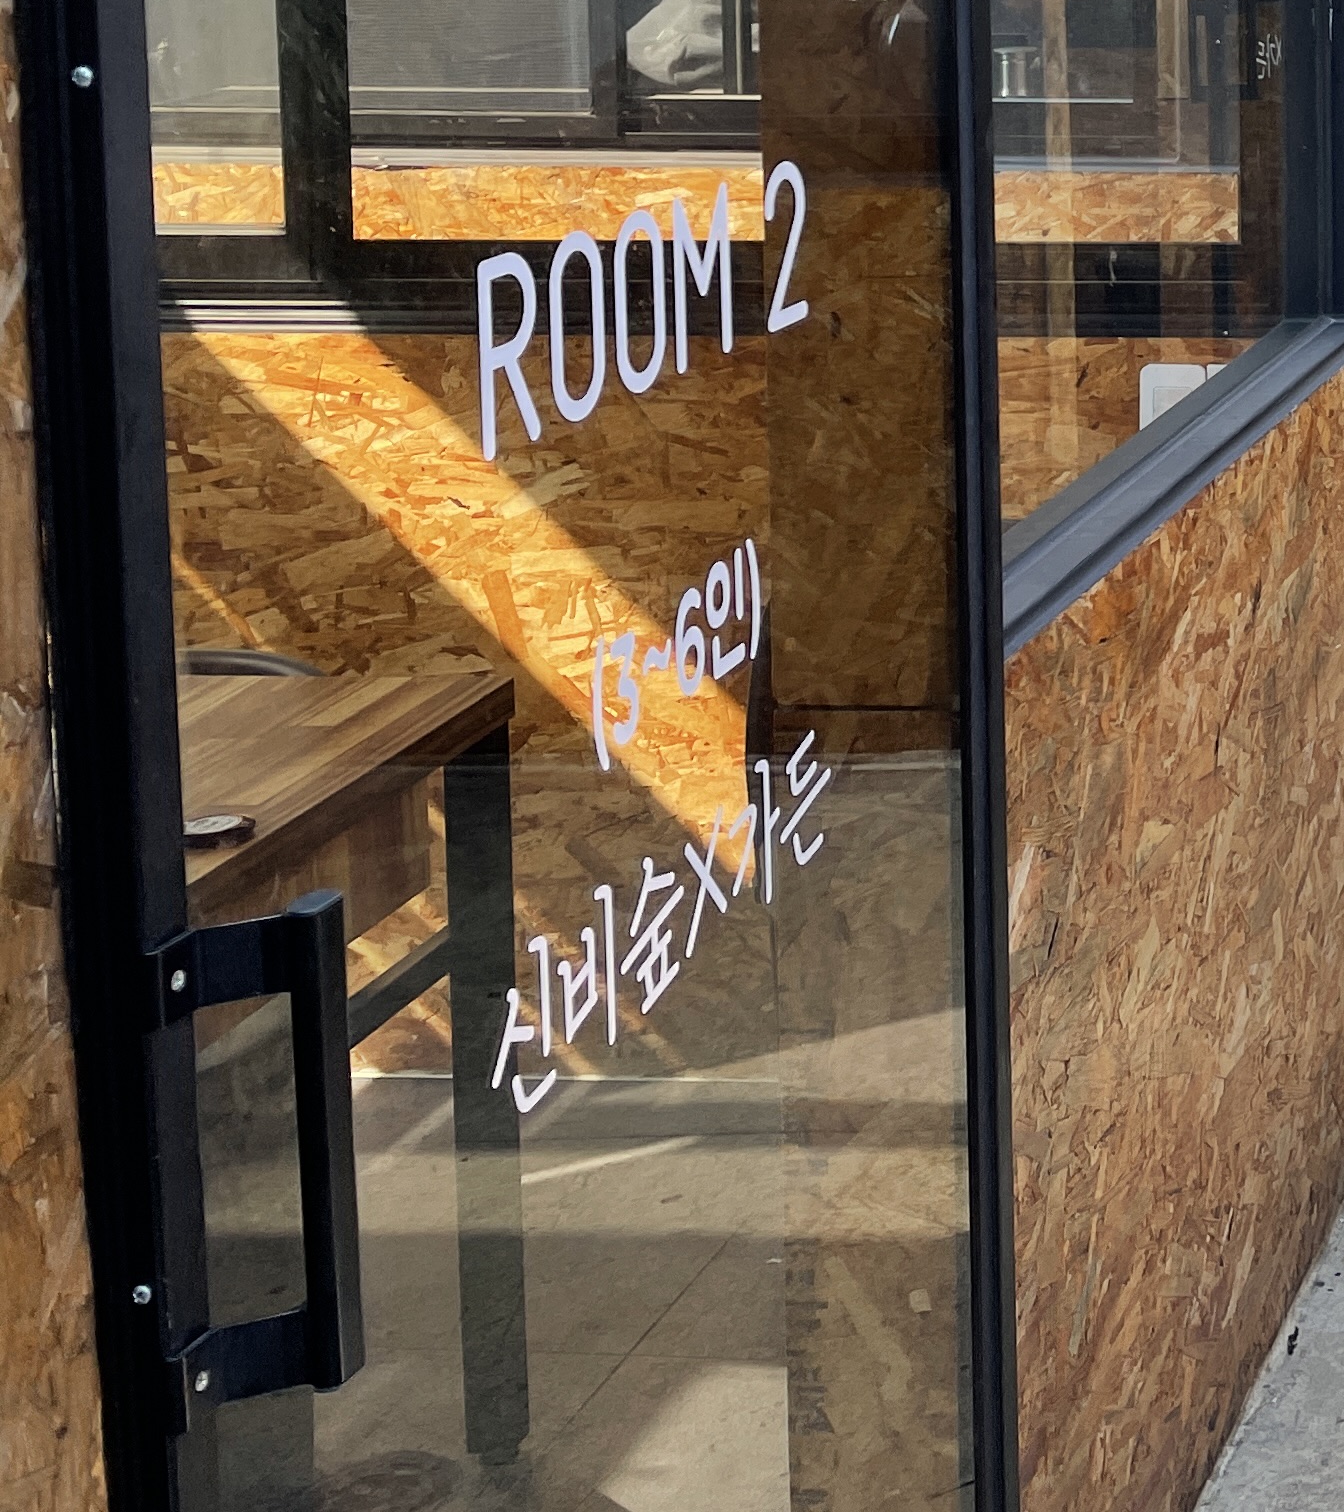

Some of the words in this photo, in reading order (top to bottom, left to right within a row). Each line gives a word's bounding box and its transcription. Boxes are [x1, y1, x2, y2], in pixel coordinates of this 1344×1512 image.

[476, 181, 734, 461] ROOM
[763, 160, 809, 334] 2
[590, 537, 762, 772] (3~6인)
[491, 728, 832, 1115] 신비숲X가든
